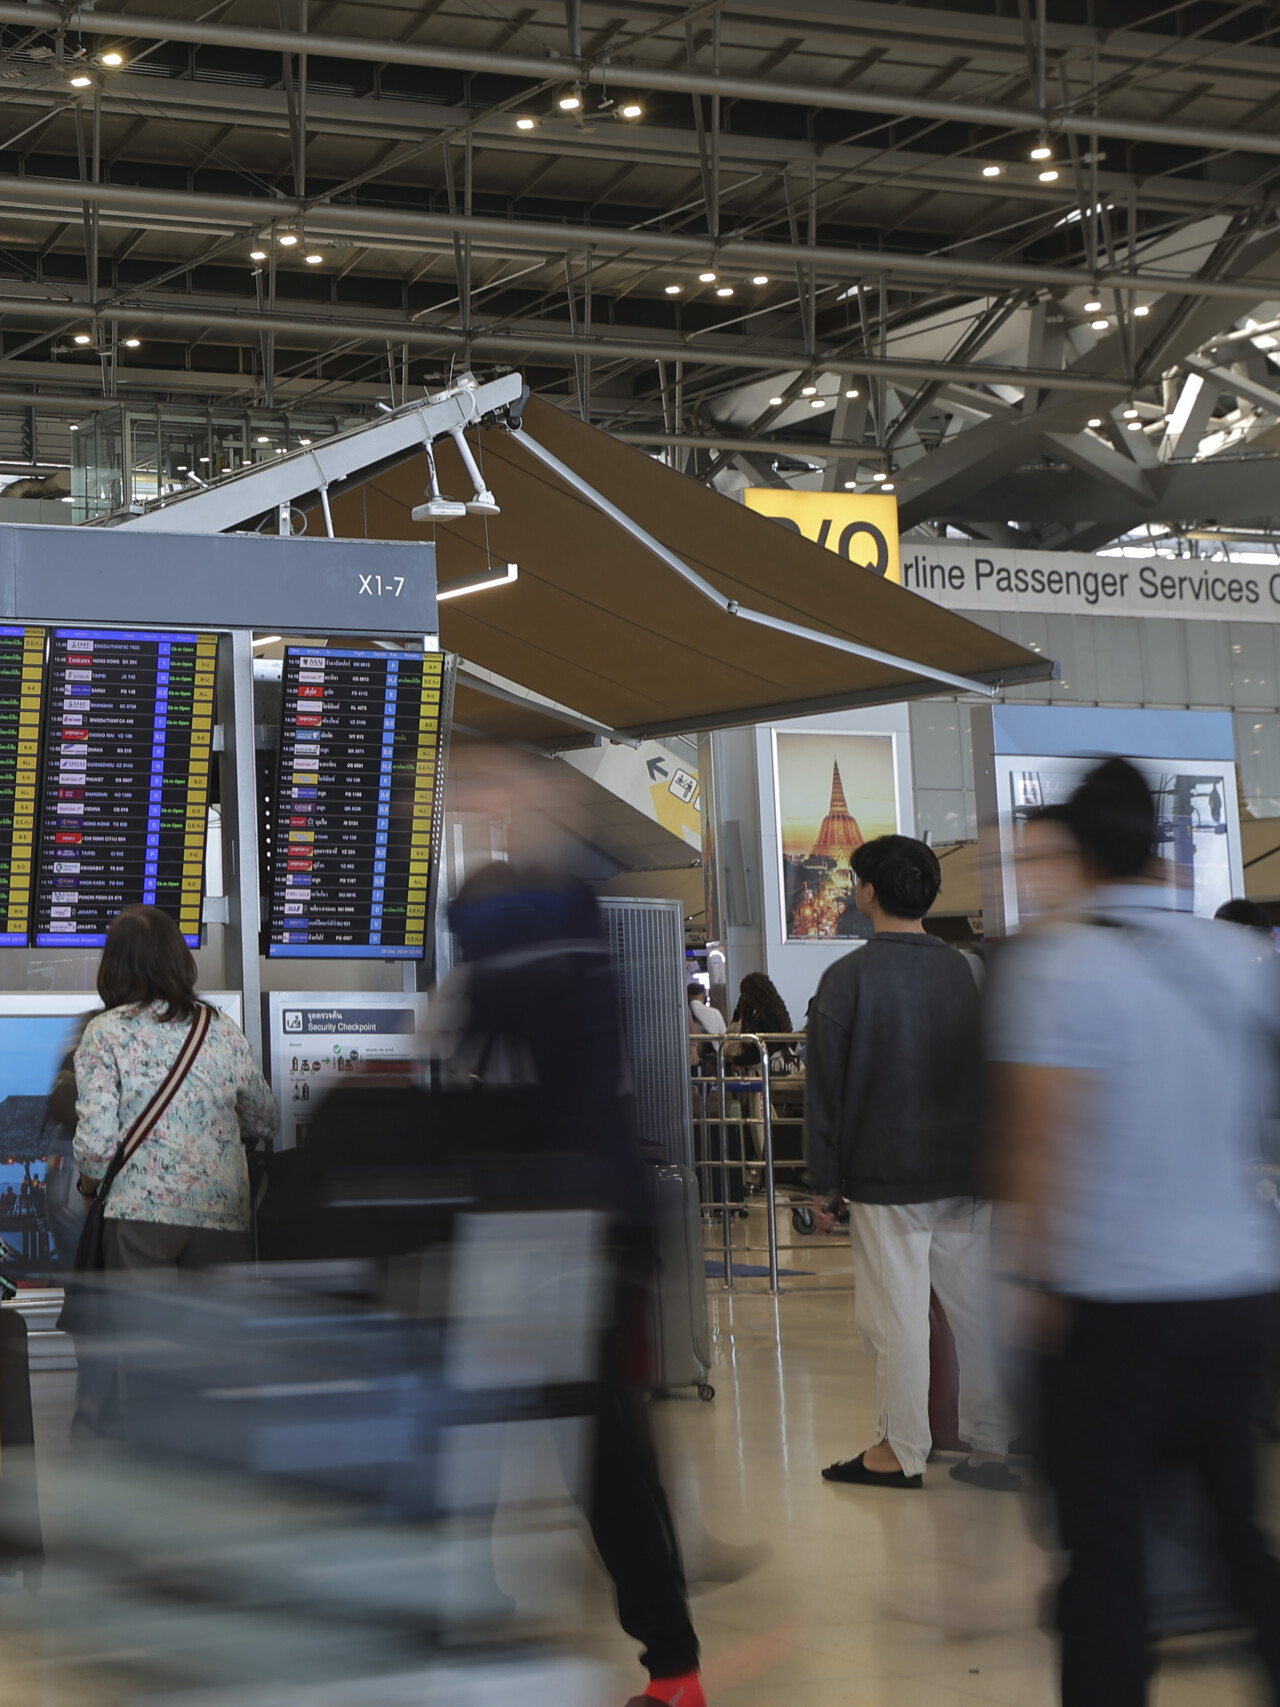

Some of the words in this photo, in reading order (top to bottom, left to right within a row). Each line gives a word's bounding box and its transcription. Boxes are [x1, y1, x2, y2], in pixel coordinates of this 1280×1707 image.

[359, 573, 405, 597] X1-7
[904, 555, 965, 591] rline
[975, 559, 1129, 603] Passenger
[1139, 566, 1260, 603] Services
[308, 1023, 336, 1032] Security
[337, 1023, 377, 1032] Checkpoint
